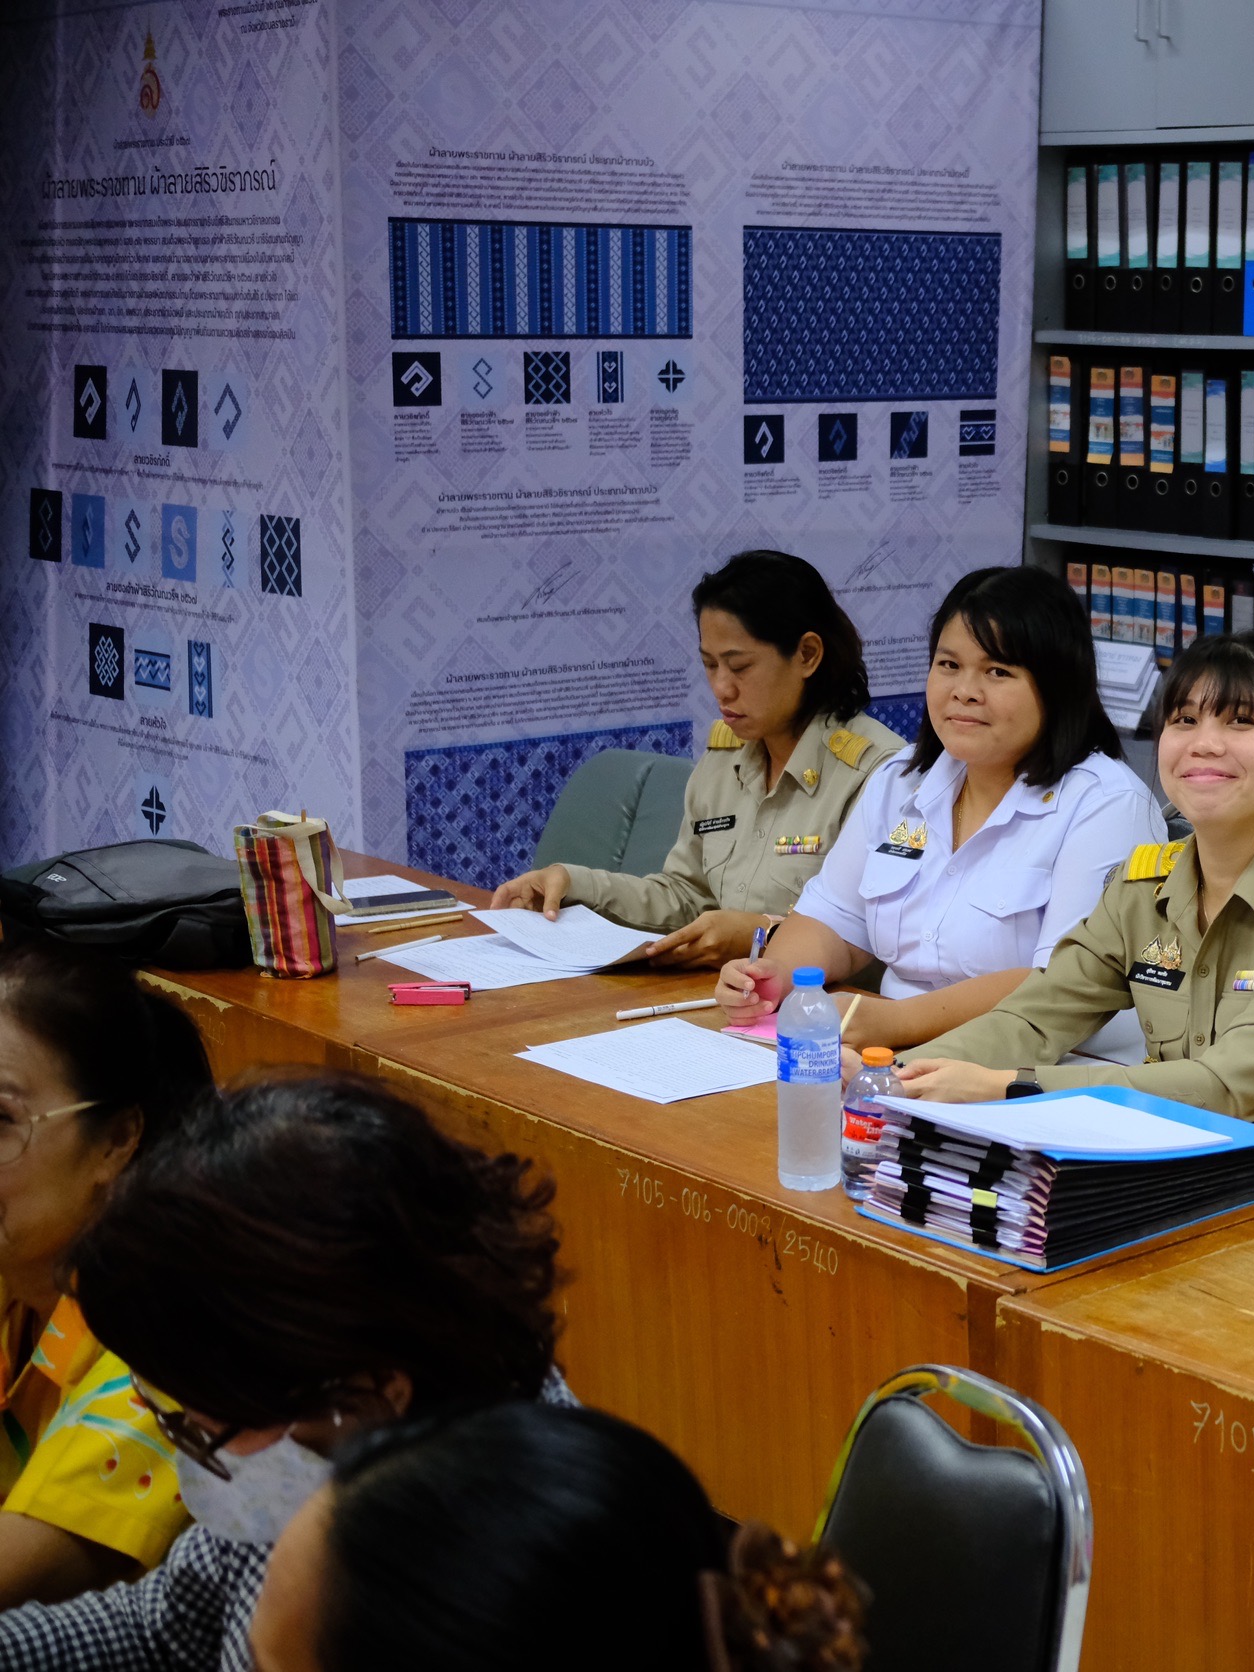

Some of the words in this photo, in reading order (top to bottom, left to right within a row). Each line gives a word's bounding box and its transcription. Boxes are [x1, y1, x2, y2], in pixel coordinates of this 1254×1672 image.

[429, 147, 507, 161] ผ้าลายพระราชทาน
[508, 150, 587, 165] ผ้าลายสิริวชิราภรณ์
[589, 154, 655, 167] ประเภทผ้ากาบบัว
[781, 160, 846, 173] ผ้าลายพระราชทาน
[42, 172, 146, 199] ผ้าลายพระราชทาน
[150, 159, 276, 195] ผ้าลายสิริวชิราภรณ์
[133, 451, 171, 467] ลายวชิรภักดิ์
[438, 492, 513, 502] ผ้าลายพระราชทาน
[515, 486, 591, 501] ผ้าลายสิริวชิราภรณ์
[593, 485, 658, 497] ประเภทผ้ากาบบัว
[446, 669, 519, 684] ผ้าลายพระราชทาน
[521, 661, 595, 680] ผ้าลายสิริวชิราภรณ์
[597, 657, 655, 671] ประเภทผ้าบาติก
[140, 715, 167, 730] ลายหัวใจ
[808, 1057, 838, 1068] DRINKING
[793, 1068, 817, 1077] WATER
[848, 1116, 873, 1129] Water
